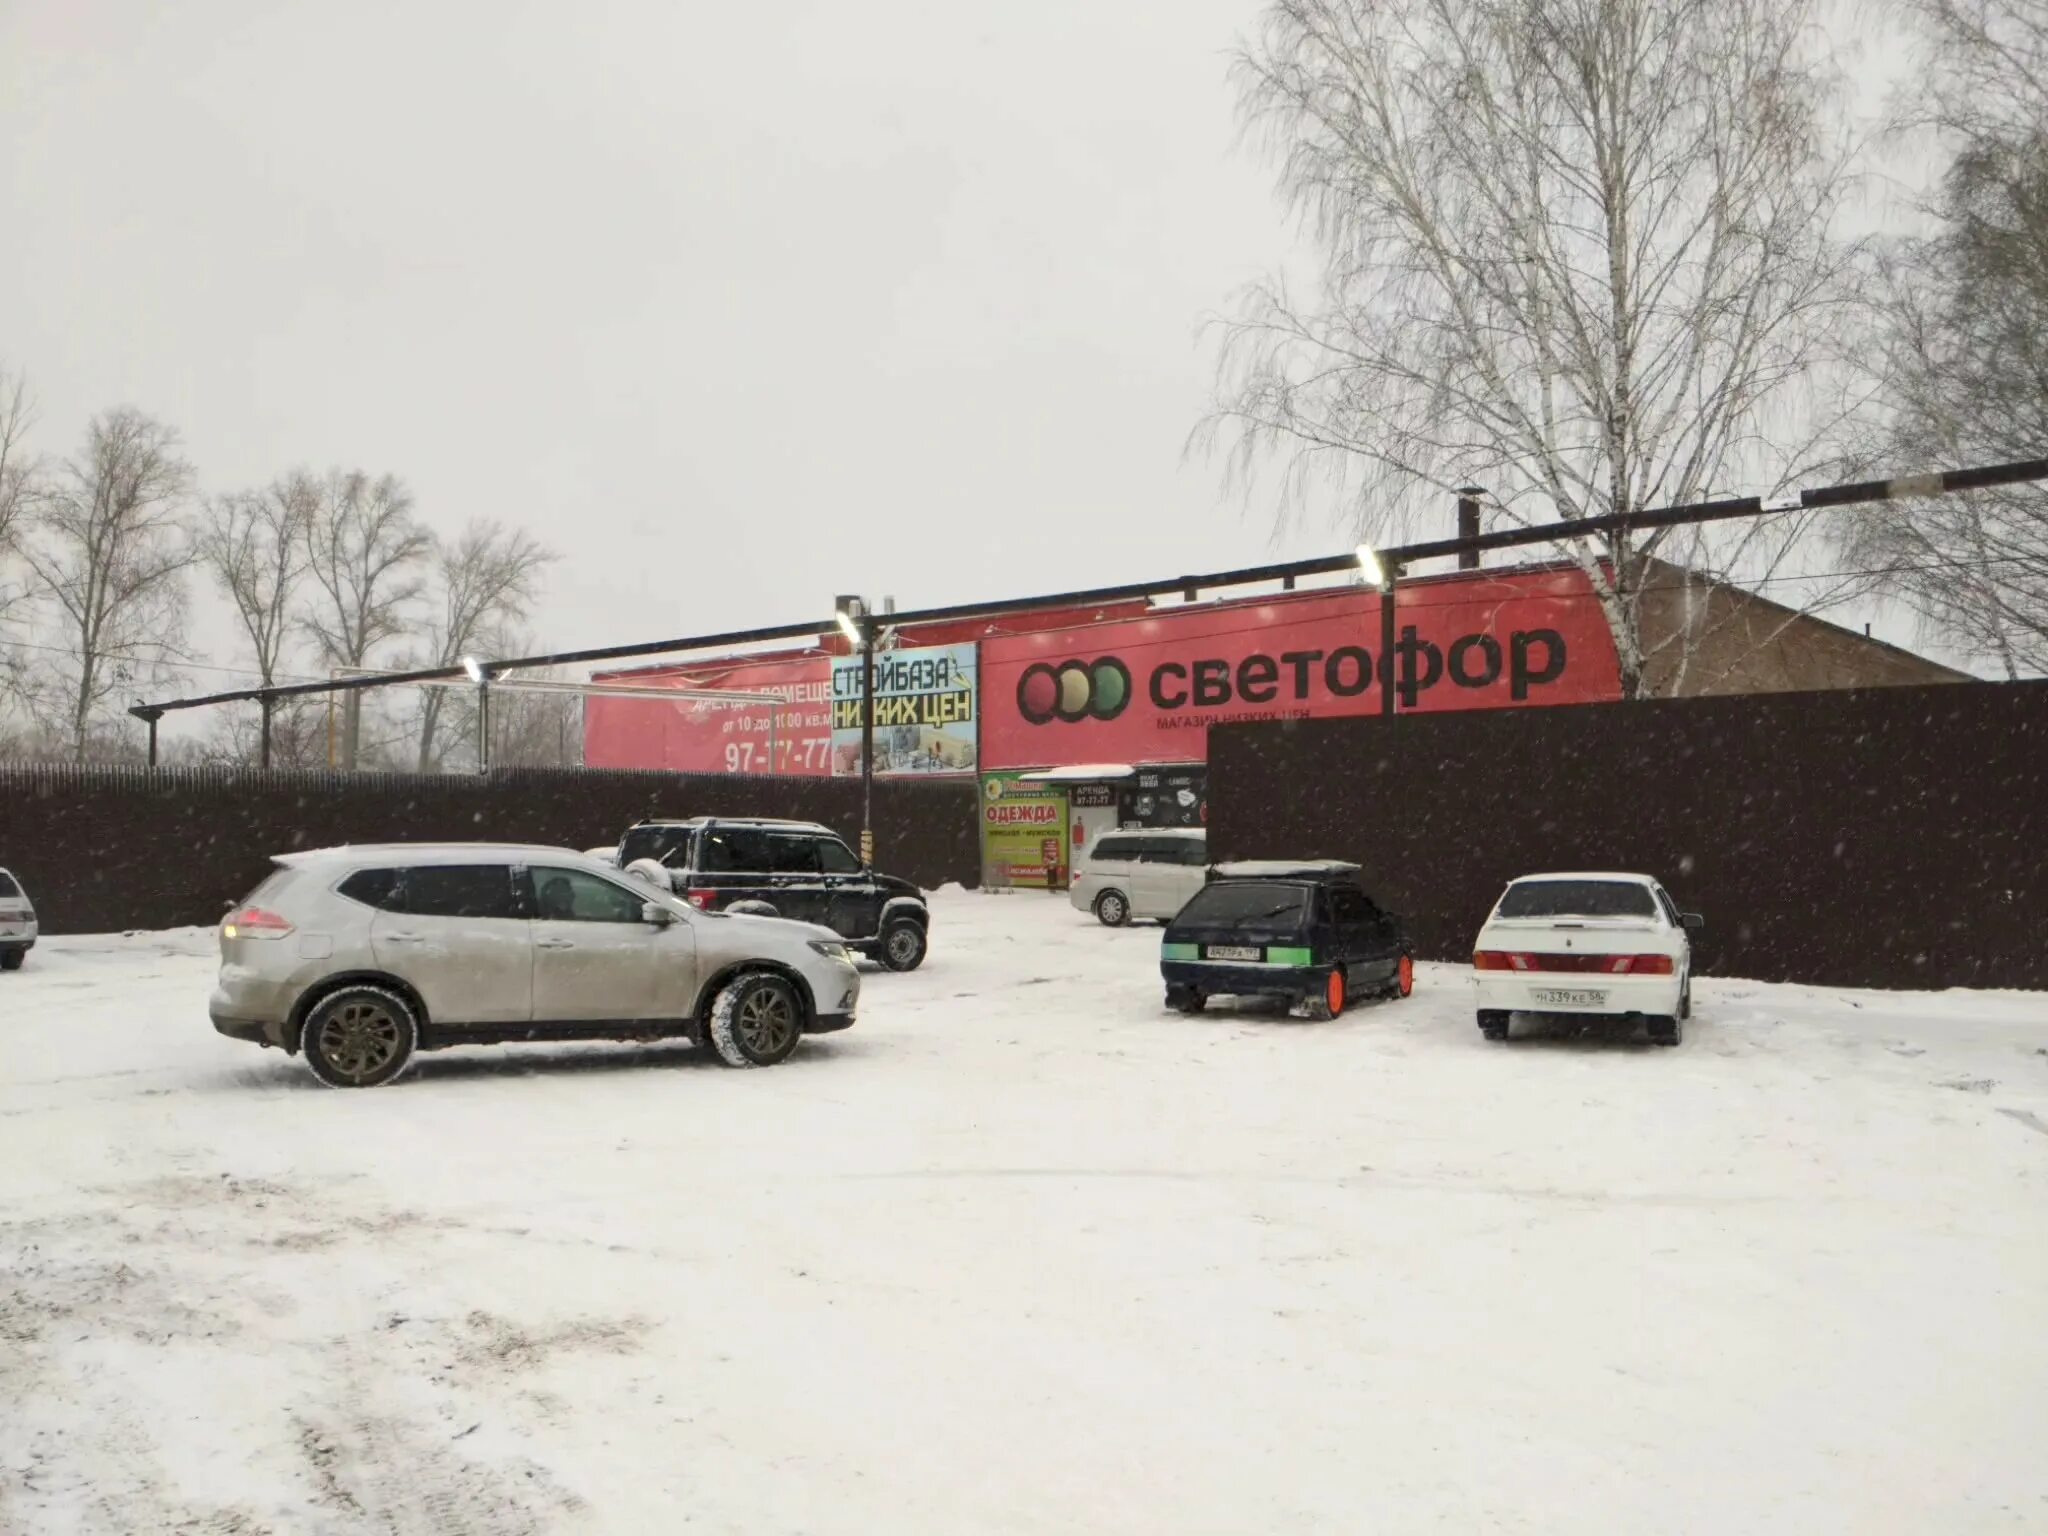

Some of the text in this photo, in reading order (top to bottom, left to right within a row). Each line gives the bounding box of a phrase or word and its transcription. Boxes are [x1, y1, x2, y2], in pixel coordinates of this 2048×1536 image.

[833, 655, 949, 695] СТРОЙБАЗА
[1149, 625, 1567, 710] светофор
[834, 691, 970, 728] НИКИХ ЦЕН
[722, 720, 734, 733] от
[739, 716, 751, 731] 10
[753, 718, 770, 732] до
[1077, 785, 1110, 795] АРЕНДА
[986, 804, 1058, 824] ОДЕЖДА
